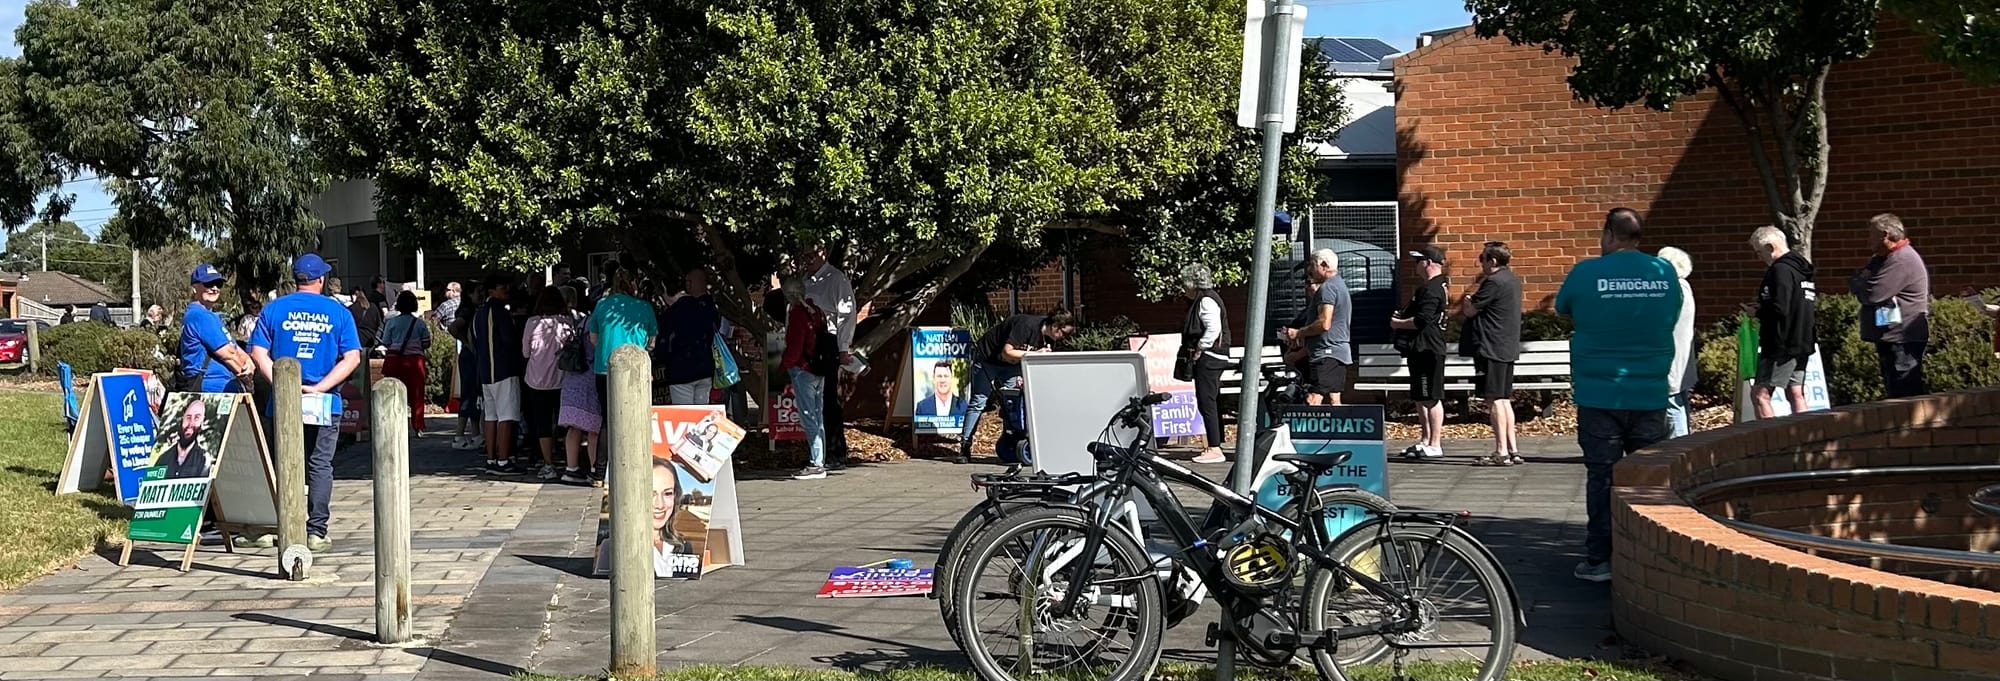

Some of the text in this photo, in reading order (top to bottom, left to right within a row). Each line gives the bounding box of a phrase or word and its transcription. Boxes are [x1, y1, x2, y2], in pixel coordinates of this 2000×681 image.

[1597, 279, 1669, 291] DEMOCRATS
[288, 311, 329, 323] NATHAN
[282, 320, 333, 333] CONROY
[925, 333, 958, 343] NATHAN
[916, 343, 967, 355] CONROY
[1152, 405, 1197, 420] Family
[1161, 421, 1192, 434] First
[1338, 465, 1367, 477] THE
[140, 483, 207, 504] MATT MABER
